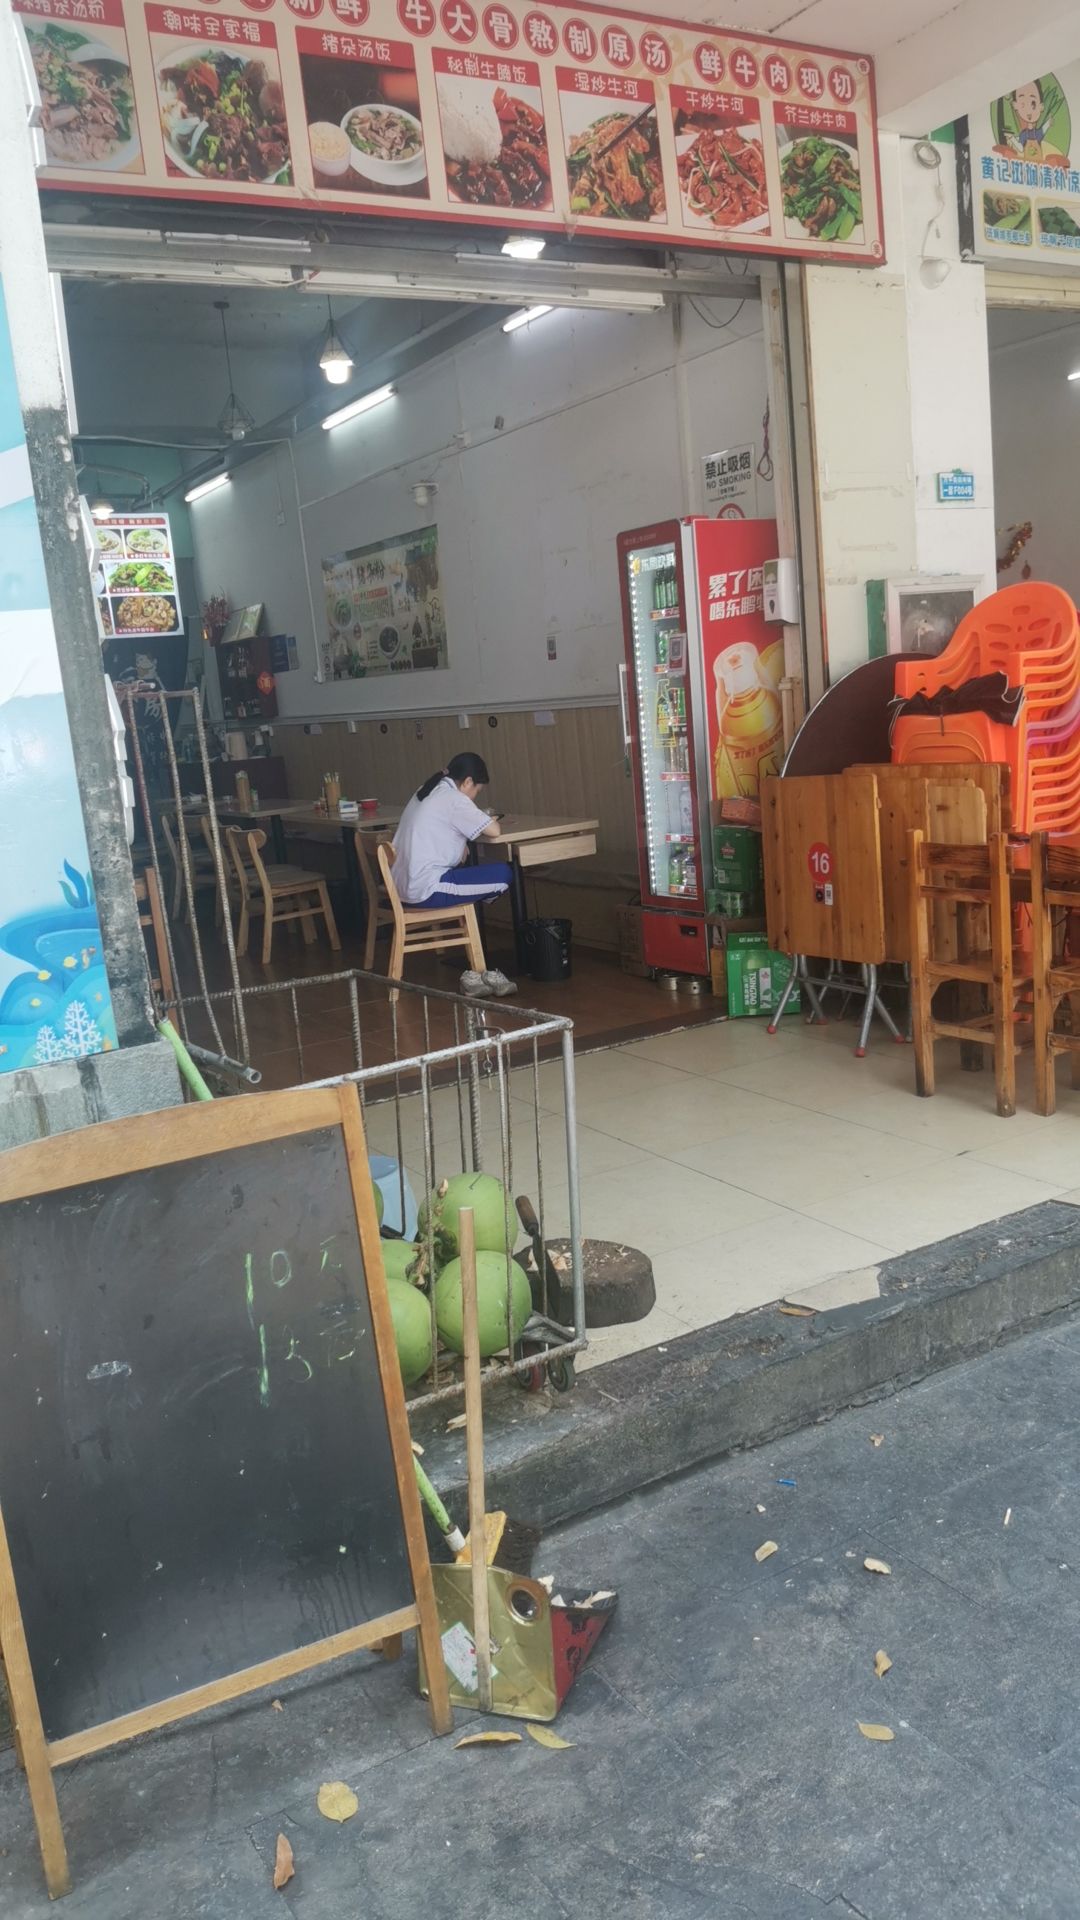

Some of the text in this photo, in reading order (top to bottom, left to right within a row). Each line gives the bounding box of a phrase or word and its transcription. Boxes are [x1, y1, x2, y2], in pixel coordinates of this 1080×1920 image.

[163, 10, 261, 43] 潮味全家福
[321, 33, 391, 62] 猪杂汤饭
[405, 2, 667, 68] 牛大骨熬制原汤
[699, 50, 854, 97] 鲜牛肉现切
[447, 54, 527, 84] 秘制牛腩饭
[575, 72, 638, 99] 湿炒牛河
[686, 90, 744, 115] 干炒牛河
[784, 105, 846, 128] 芥兰炒牛肉
[705, 451, 751, 480] 禁止吸烟
[706, 472, 752, 490] NO SMOKING
[708, 567, 763, 599] 累了困
[811, 851, 830, 874] 16
